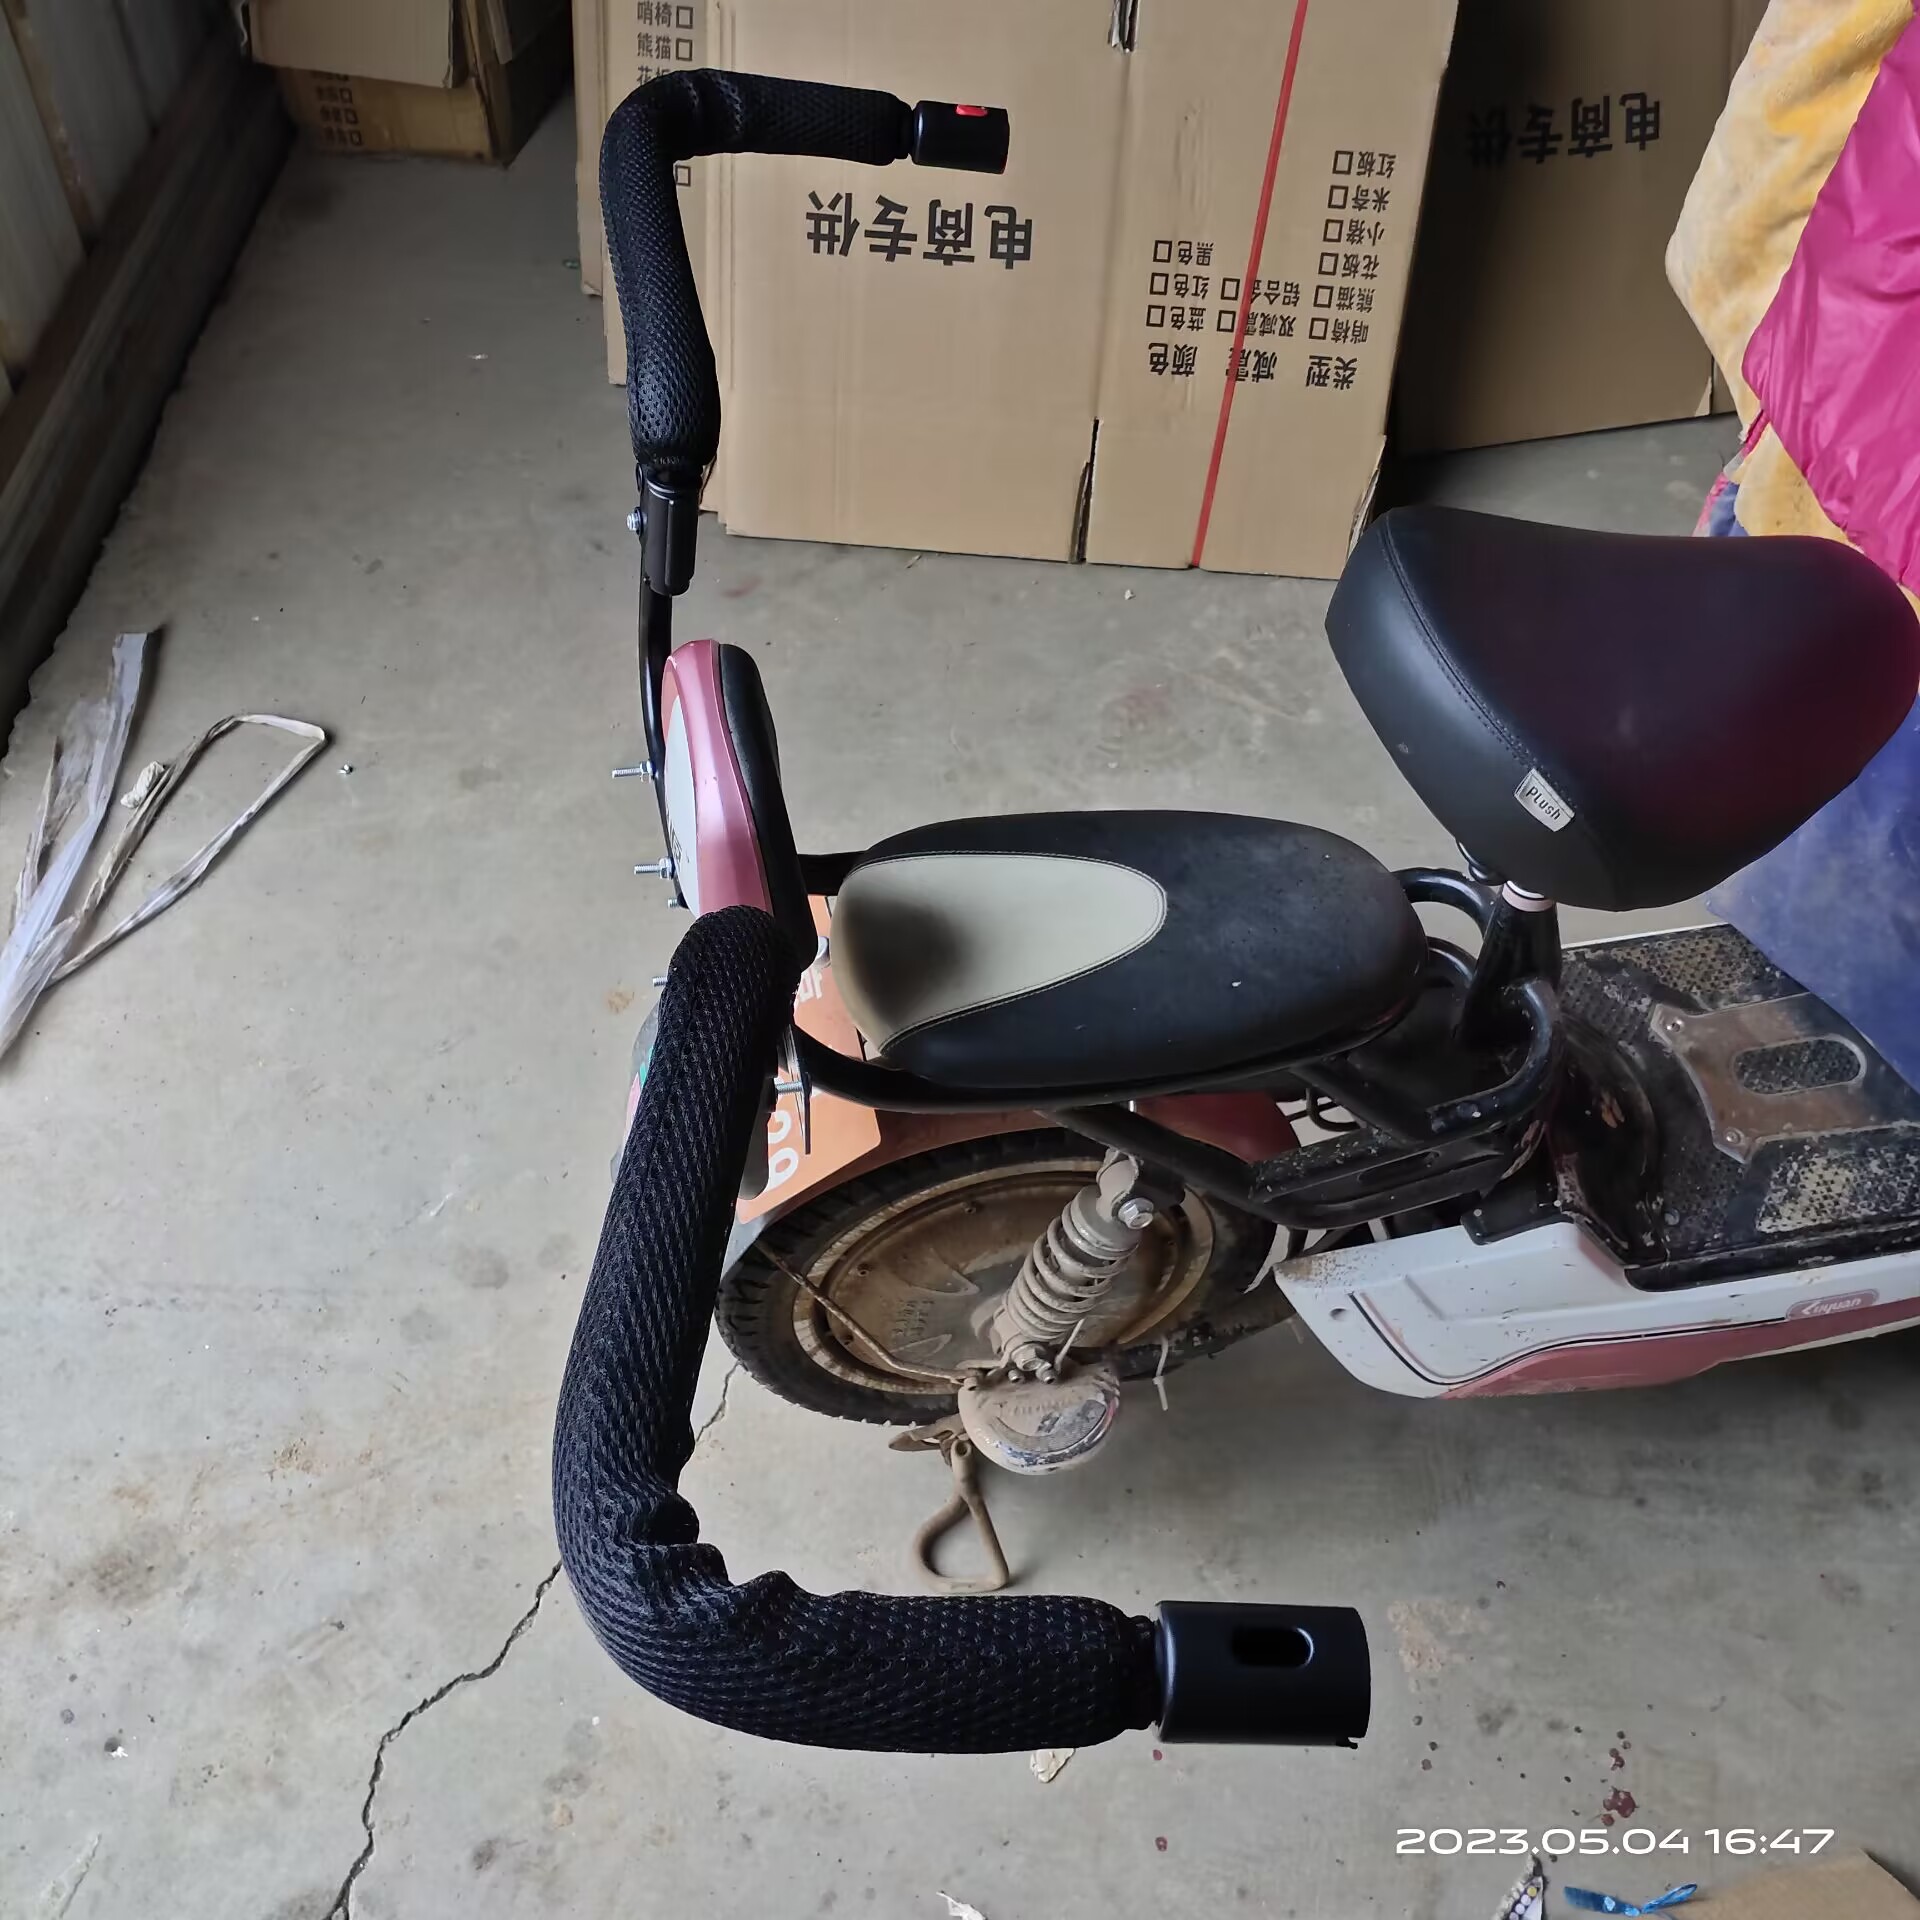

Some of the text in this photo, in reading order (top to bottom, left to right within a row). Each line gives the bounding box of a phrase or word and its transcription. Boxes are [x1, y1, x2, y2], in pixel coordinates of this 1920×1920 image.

[637, 1, 672, 28] 哨椅
[637, 32, 671, 60] 熊猫
[1356, 151, 1396, 178] 红板
[1352, 184, 1390, 213] 米奇
[806, 190, 1033, 270] 电商专供
[1346, 218, 1384, 246] 小猪
[1178, 240, 1214, 266] 黑色
[1341, 253, 1380, 280] 花板
[1174, 273, 1210, 300] 红色
[1336, 286, 1375, 313] 熊猫
[1170, 306, 1207, 332] 蓝色
[1331, 318, 1369, 344] 哨椅
[1148, 342, 1198, 378] 颜色
[1306, 355, 1358, 390] 类型
